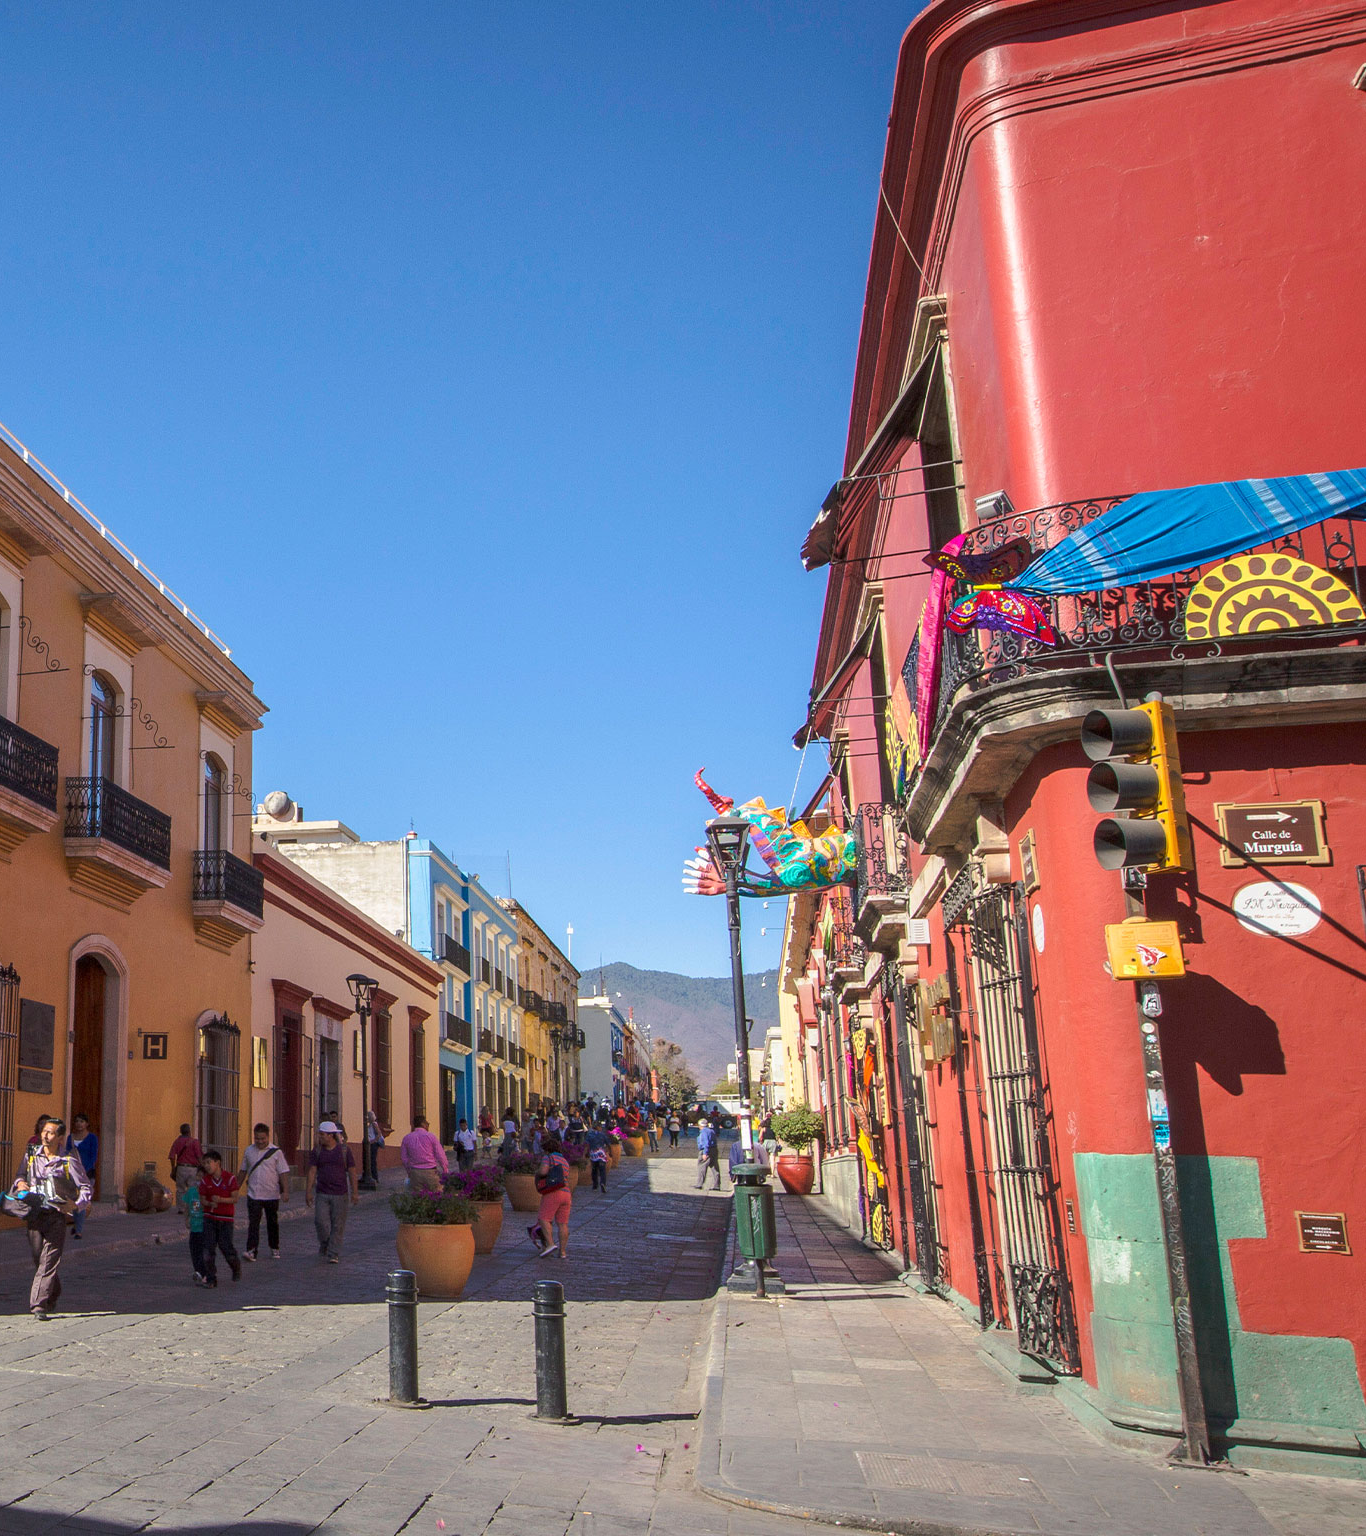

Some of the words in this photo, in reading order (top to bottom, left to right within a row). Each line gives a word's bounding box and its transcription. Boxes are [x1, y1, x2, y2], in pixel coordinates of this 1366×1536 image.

[1252, 830, 1277, 840] Calle
[1279, 830, 1291, 839] de
[1243, 841, 1303, 855] Murguía
[147, 1036, 163, 1057] H
